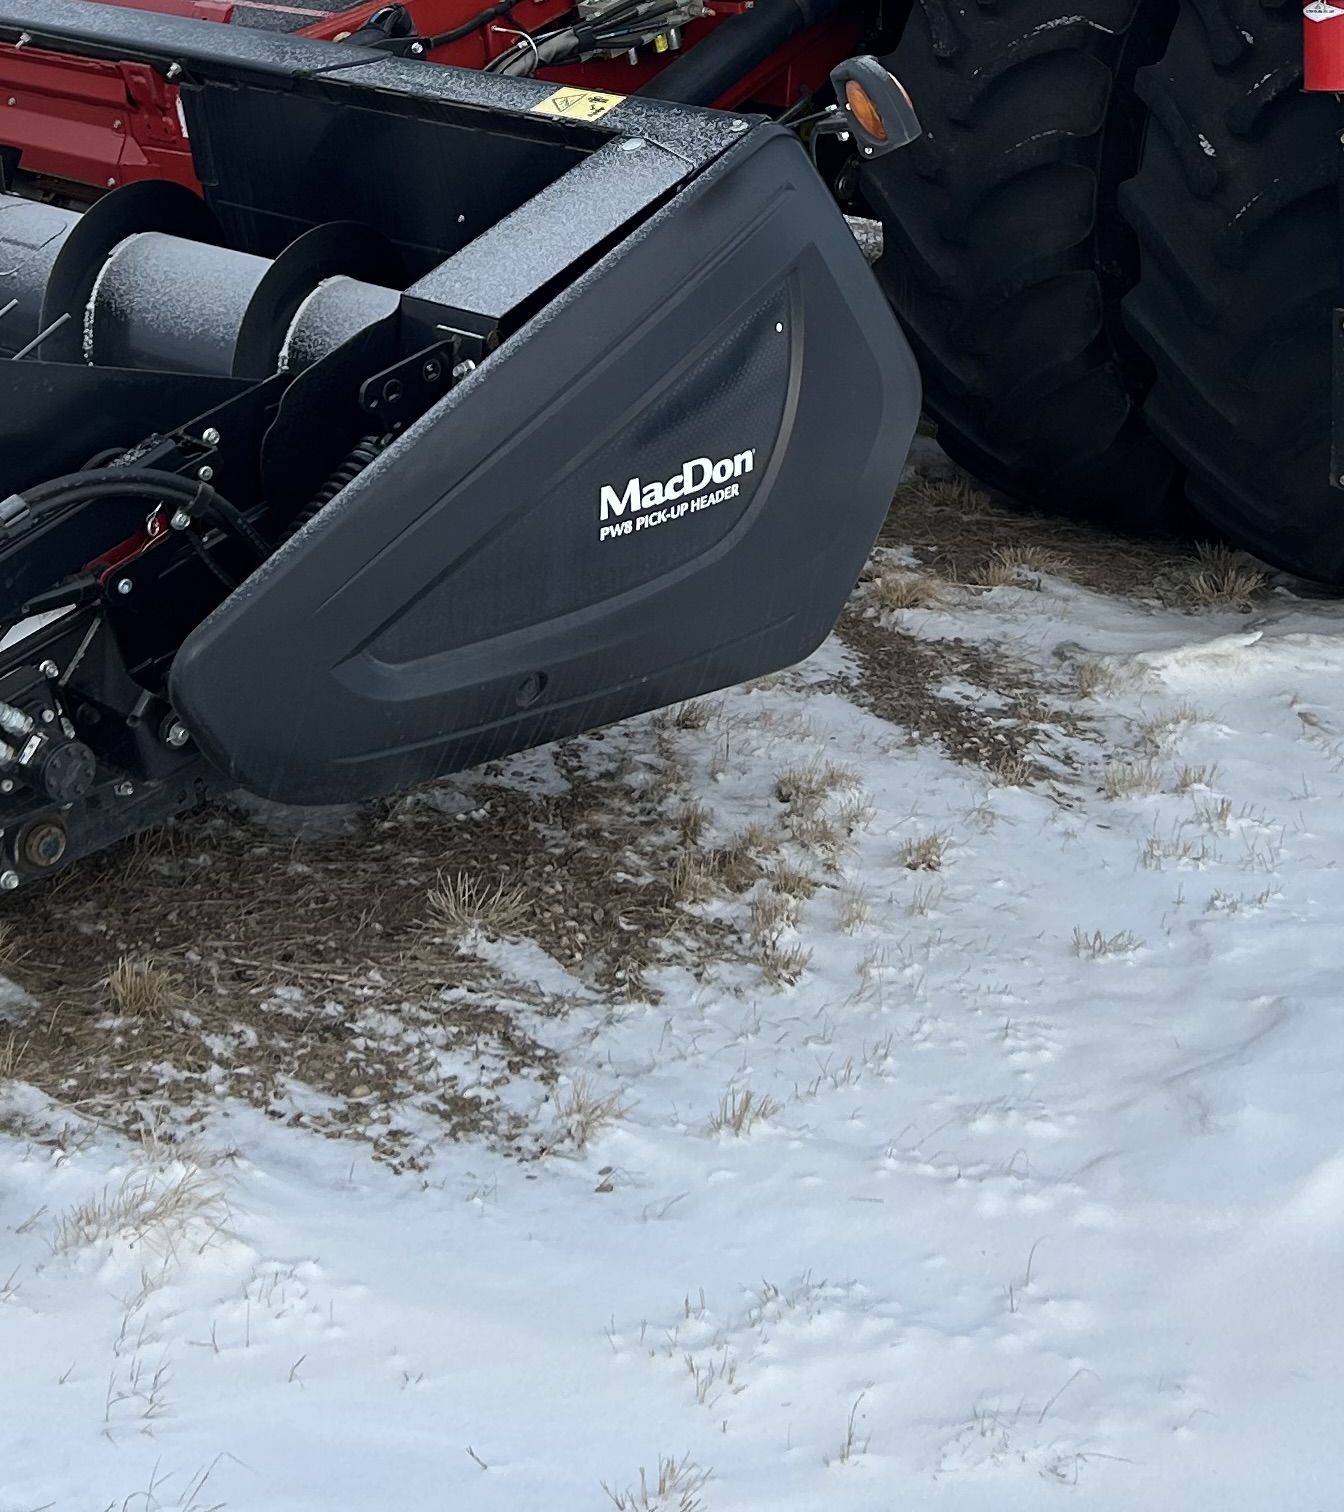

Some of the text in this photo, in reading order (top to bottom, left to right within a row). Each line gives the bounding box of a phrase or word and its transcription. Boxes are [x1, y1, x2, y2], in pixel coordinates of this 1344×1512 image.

[599, 448, 755, 521] MacDon
[599, 483, 740, 541] PW8 PICK-UP HEADER
